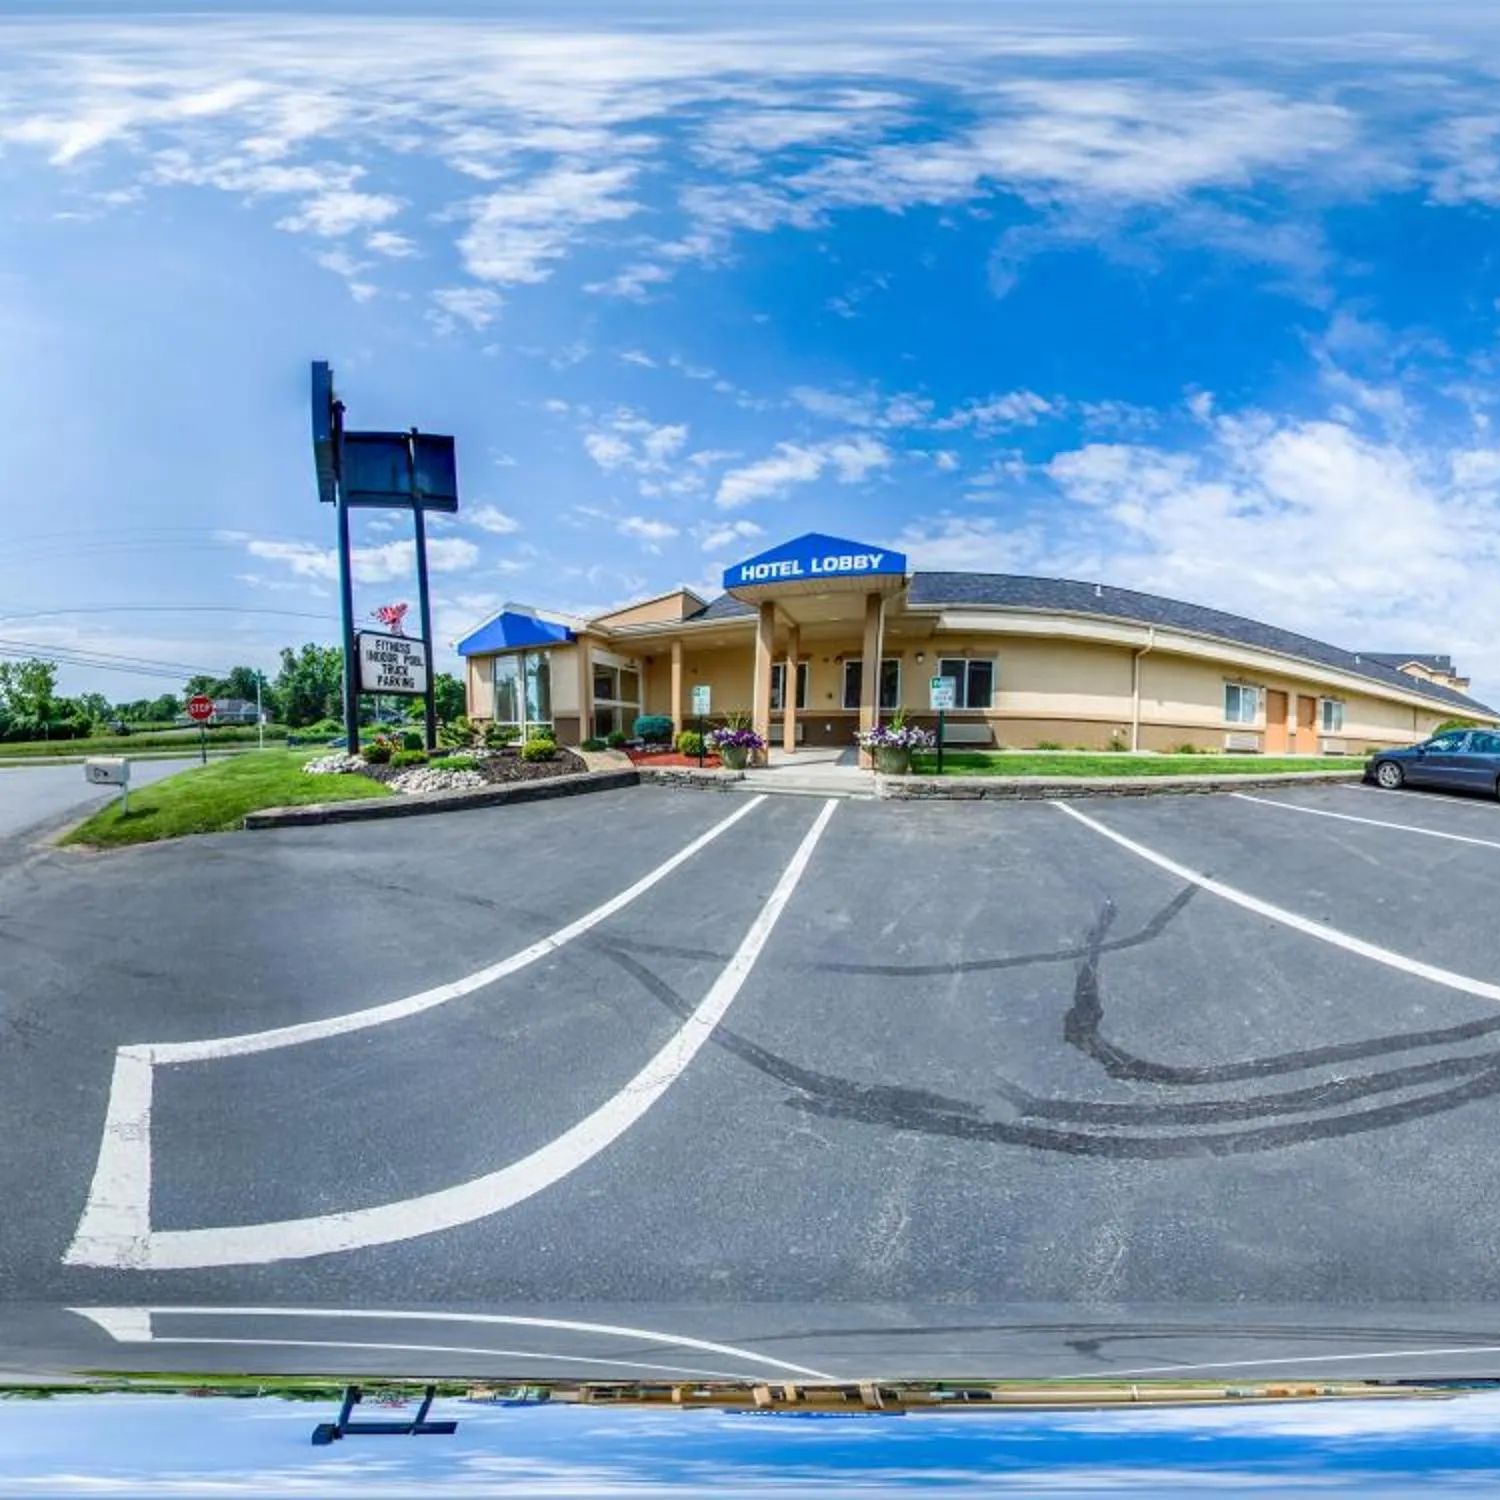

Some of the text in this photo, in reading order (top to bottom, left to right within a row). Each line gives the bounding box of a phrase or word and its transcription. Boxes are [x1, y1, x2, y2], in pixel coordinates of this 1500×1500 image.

[741, 553, 884, 581] HOTEL LOBBY
[375, 640, 411, 654] FITNESS
[366, 650, 424, 666] INDOOR POOL
[382, 664, 409, 676] TRUCK
[377, 675, 415, 688] PARKING
[189, 703, 211, 713] STOP
